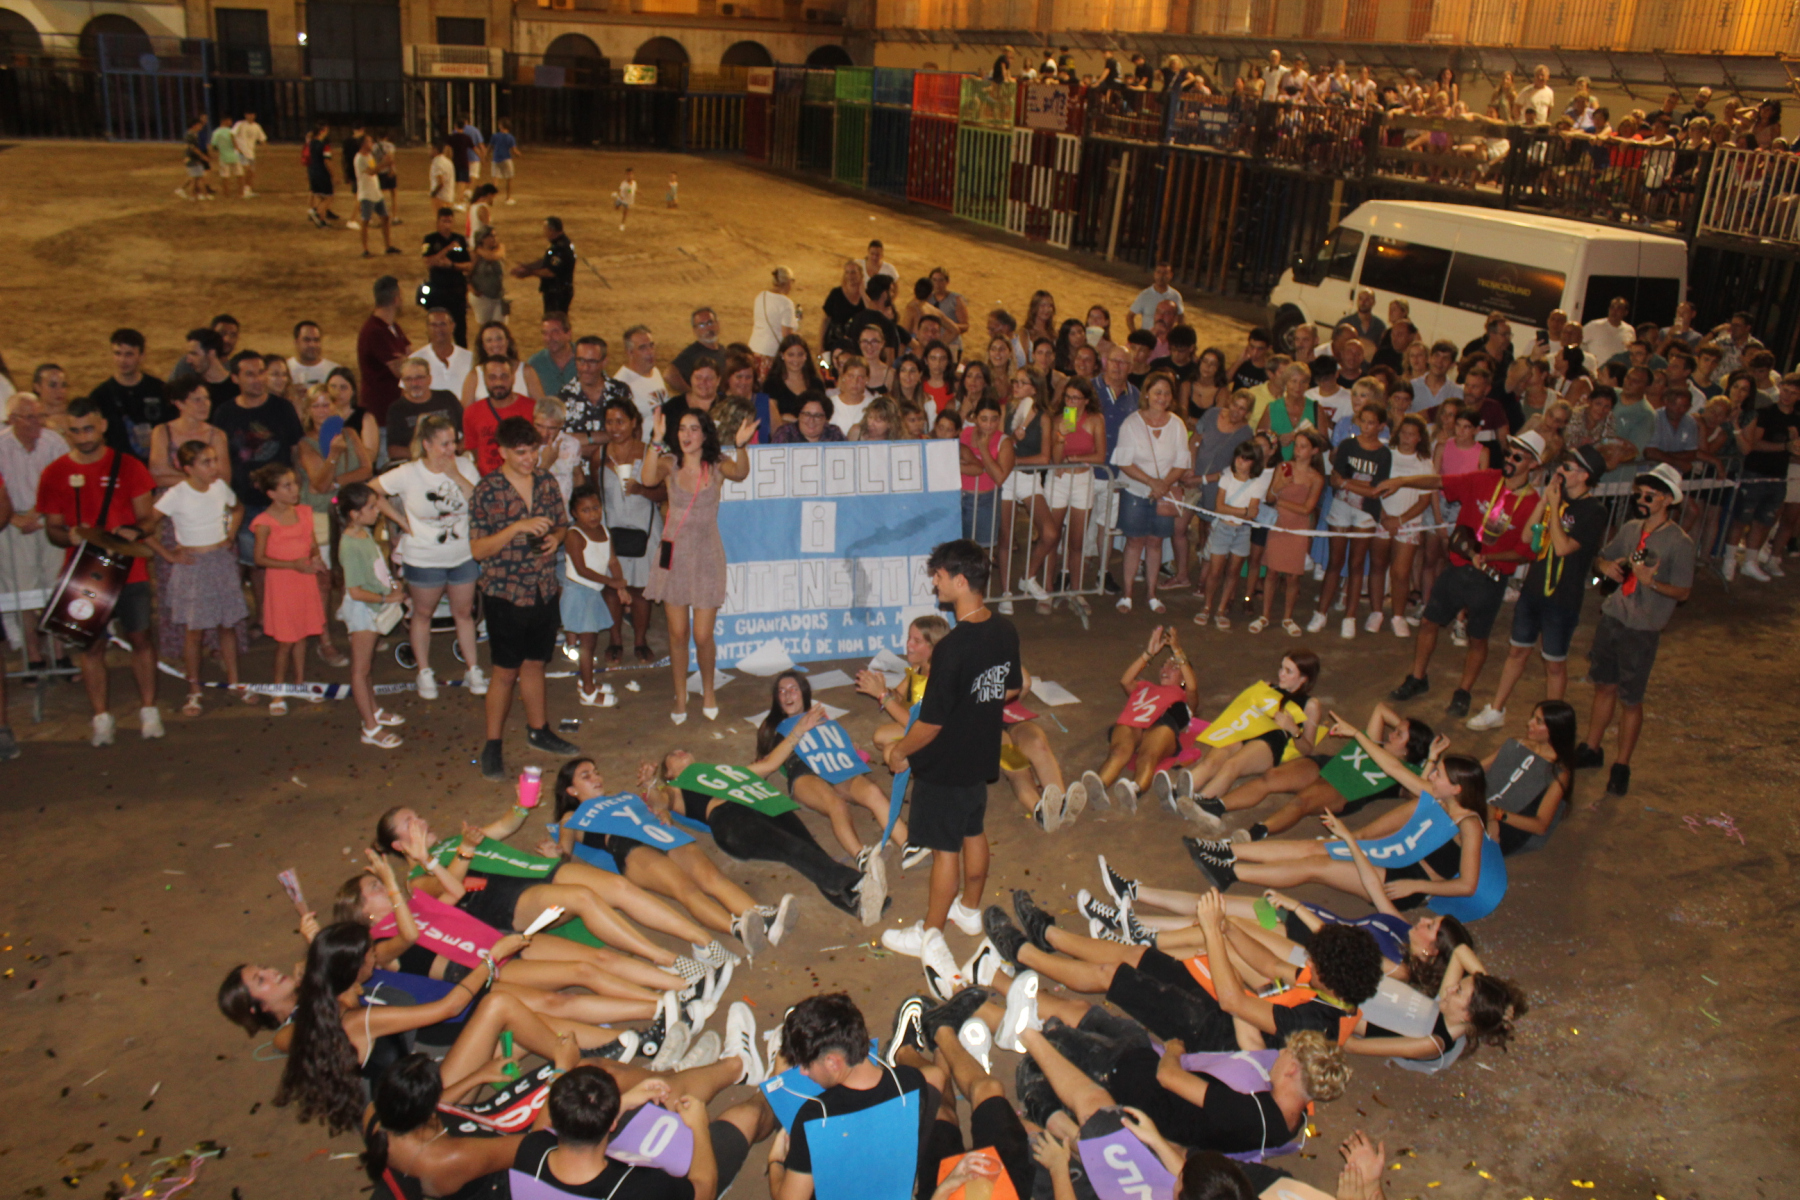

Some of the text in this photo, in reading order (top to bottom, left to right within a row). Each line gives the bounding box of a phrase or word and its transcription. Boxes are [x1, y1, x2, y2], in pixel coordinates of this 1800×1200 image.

[842, 611, 854, 627] A
[865, 611, 887, 627] LA
[815, 638, 833, 655] DE
[838, 638, 864, 653] NOM
[867, 635, 886, 651] DE
[727, 781, 781, 805] PRE
